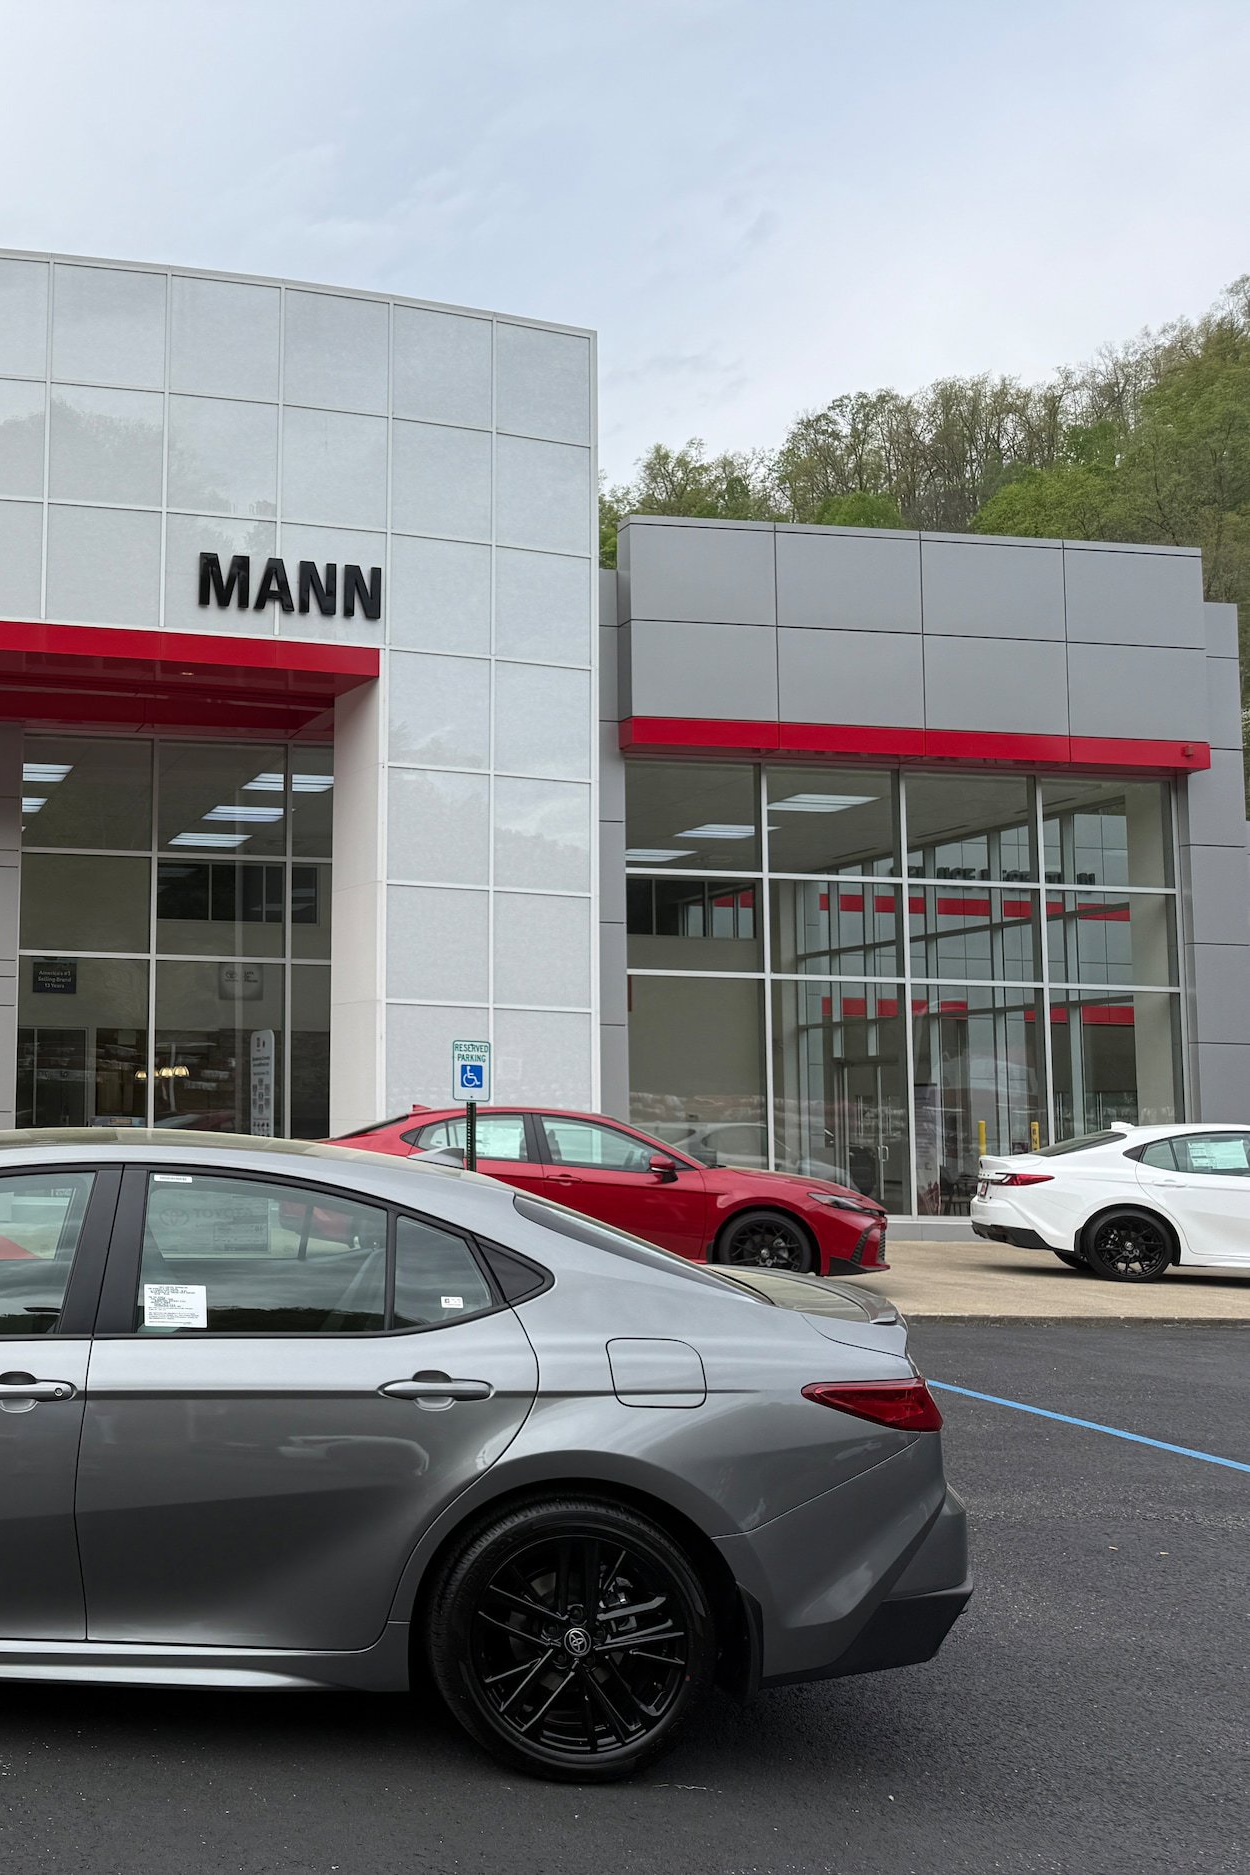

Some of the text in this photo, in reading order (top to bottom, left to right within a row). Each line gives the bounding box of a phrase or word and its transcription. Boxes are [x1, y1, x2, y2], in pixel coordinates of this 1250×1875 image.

[198, 552, 381, 619] MANN
[455, 1043, 488, 1052] RESERVED
[457, 1054, 486, 1063] PARKING
